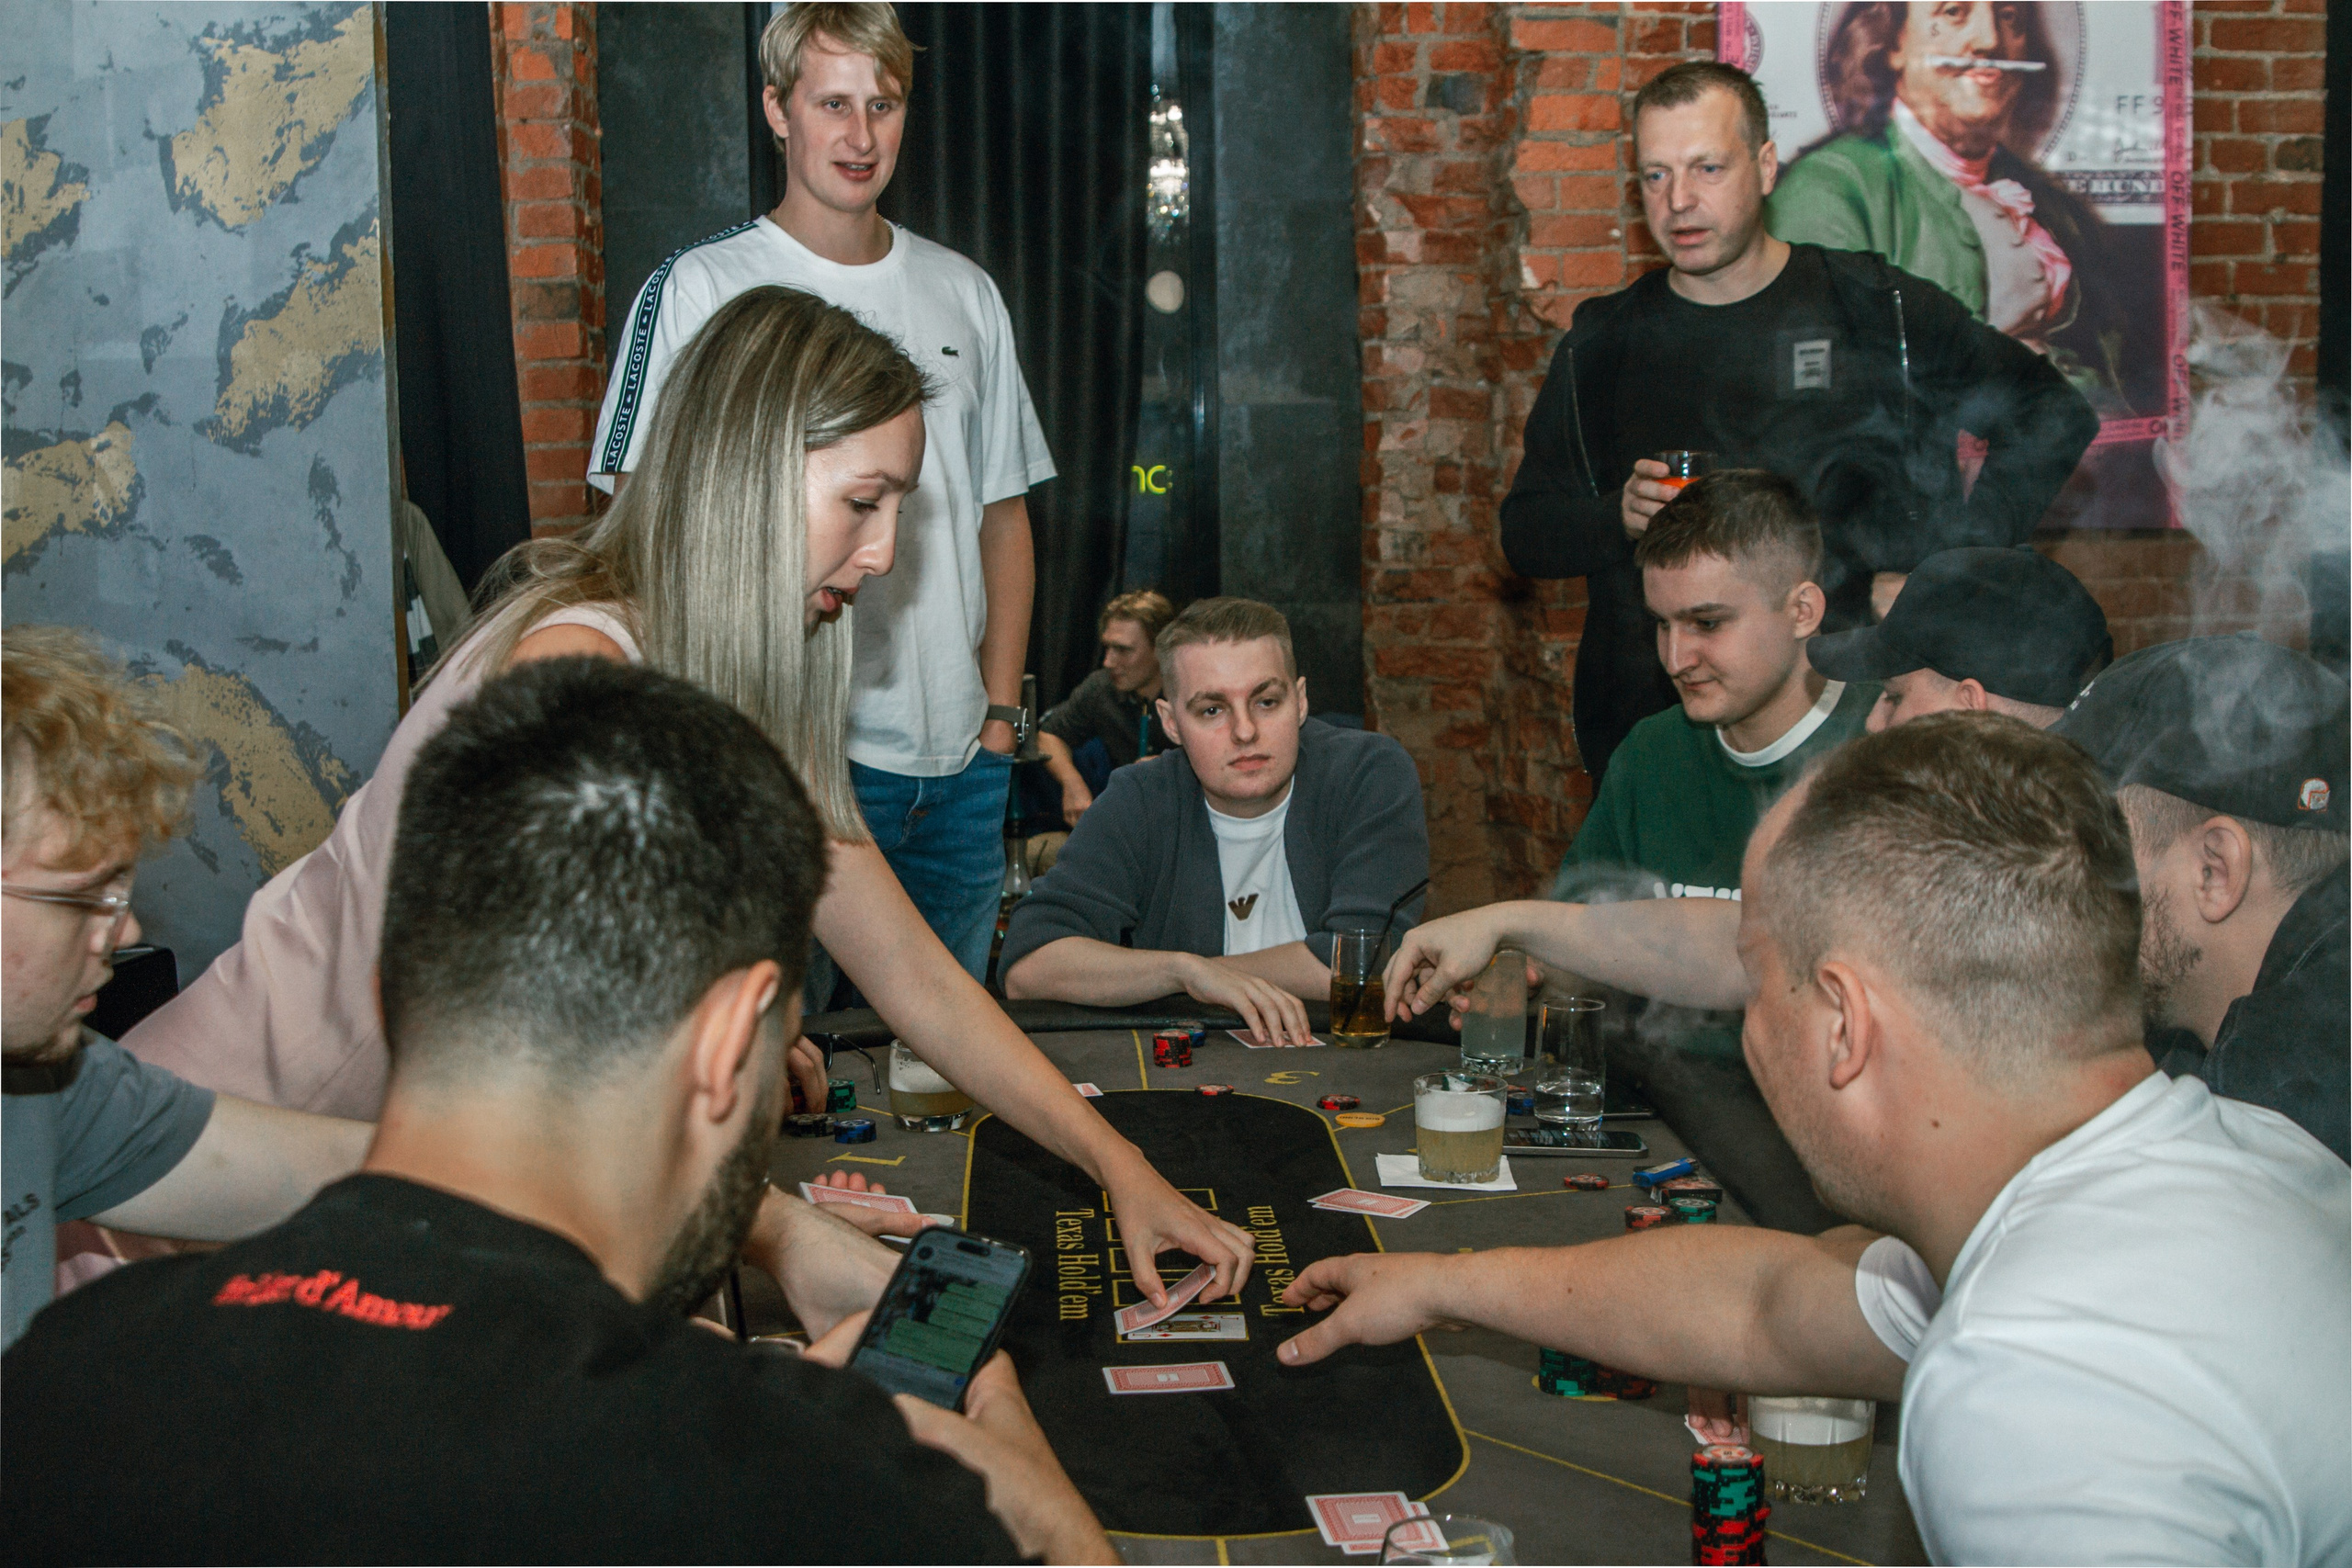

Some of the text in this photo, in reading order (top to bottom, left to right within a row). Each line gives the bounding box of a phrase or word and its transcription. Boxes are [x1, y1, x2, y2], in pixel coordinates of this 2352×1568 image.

[644, 255, 673, 311] LACOSTE
[628, 328, 648, 390] LACOSTE
[606, 407, 632, 467] LACOSTE
[1056, 1208, 1095, 1250] Texas
